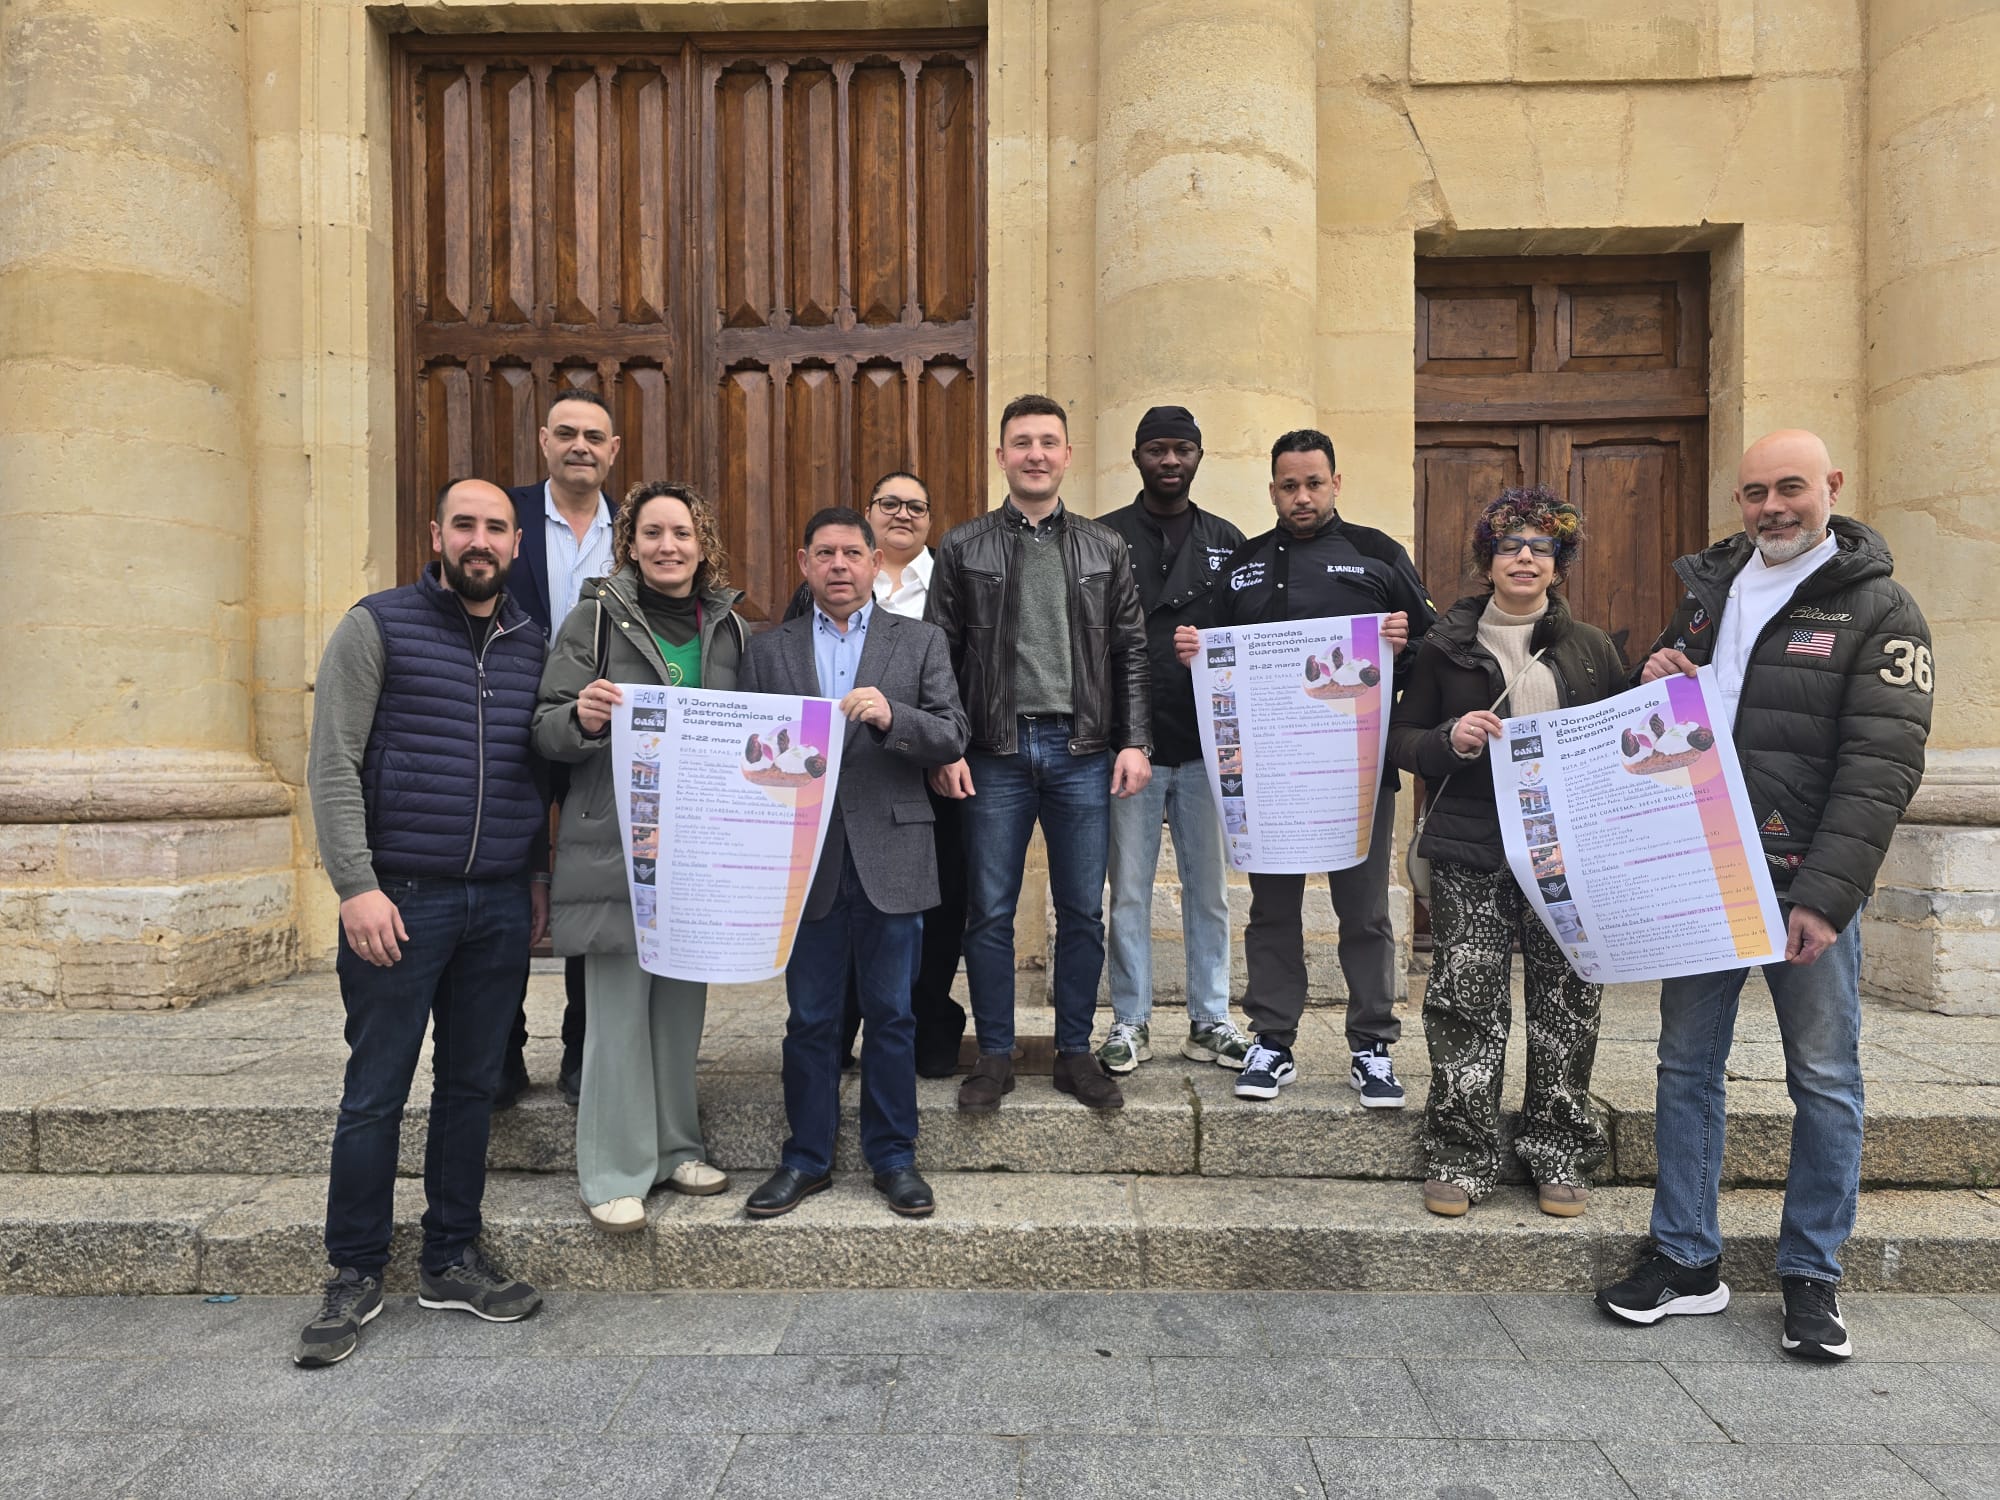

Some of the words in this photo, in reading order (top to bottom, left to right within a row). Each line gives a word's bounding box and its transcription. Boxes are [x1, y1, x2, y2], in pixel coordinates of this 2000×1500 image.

[1789, 606, 1853, 622] Blauer
[1253, 630, 1303, 640] Jornadas
[1248, 636, 1327, 650] gastronómicas
[1248, 647, 1300, 656] cuaresma
[1880, 639, 1933, 694] 36
[691, 698, 748, 710] Jornadas
[683, 707, 774, 721] gastronómicas
[777, 714, 792, 722] de
[1548, 720, 1558, 728] VI
[1561, 707, 1616, 726] Jornadas
[1556, 706, 1641, 738] gastronómicas
[1644, 700, 1660, 709] de
[682, 718, 743, 728] cuaresma
[681, 734, 709, 742] 21-22
[1557, 724, 1614, 744] cuaresma
[1560, 749, 1587, 760] 21-22
[1588, 739, 1616, 752] marzo
